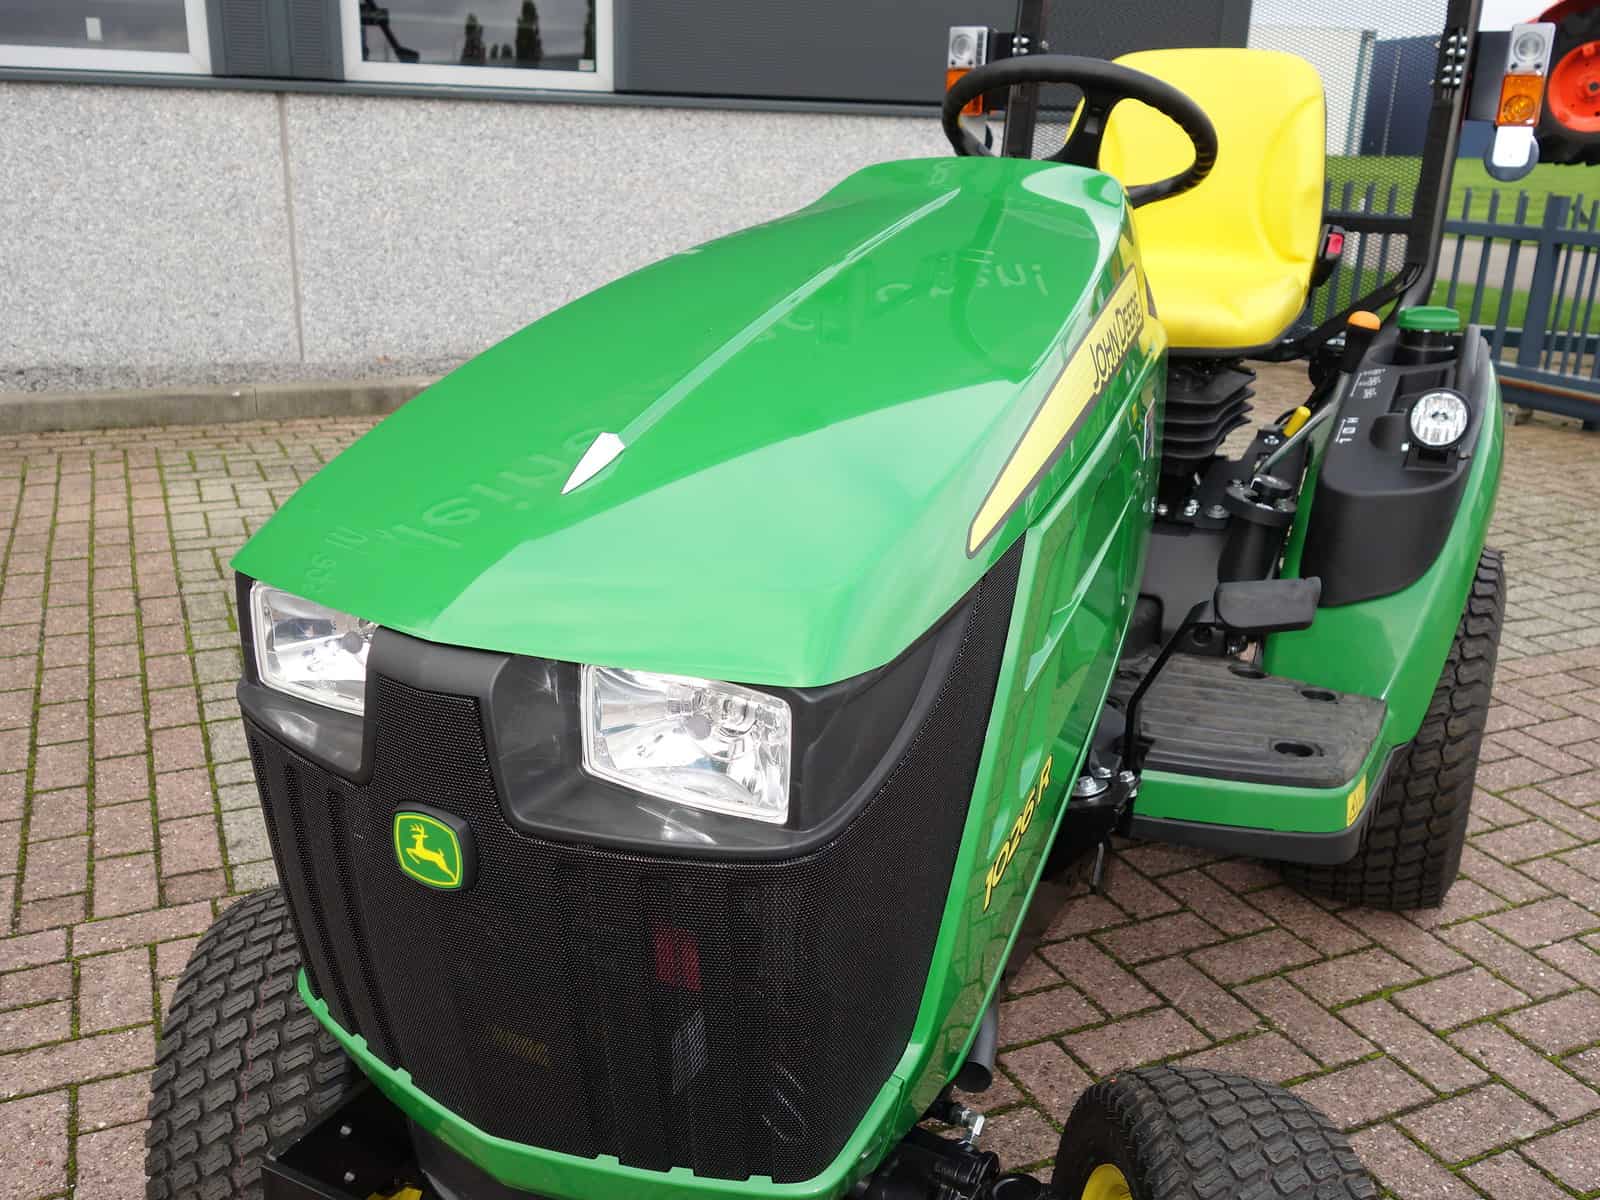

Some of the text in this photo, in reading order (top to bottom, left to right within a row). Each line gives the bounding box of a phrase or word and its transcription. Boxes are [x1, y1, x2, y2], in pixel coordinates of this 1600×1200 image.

[1089, 292, 1141, 389] JOHN DEERE
[983, 754, 1053, 913] 1026R
